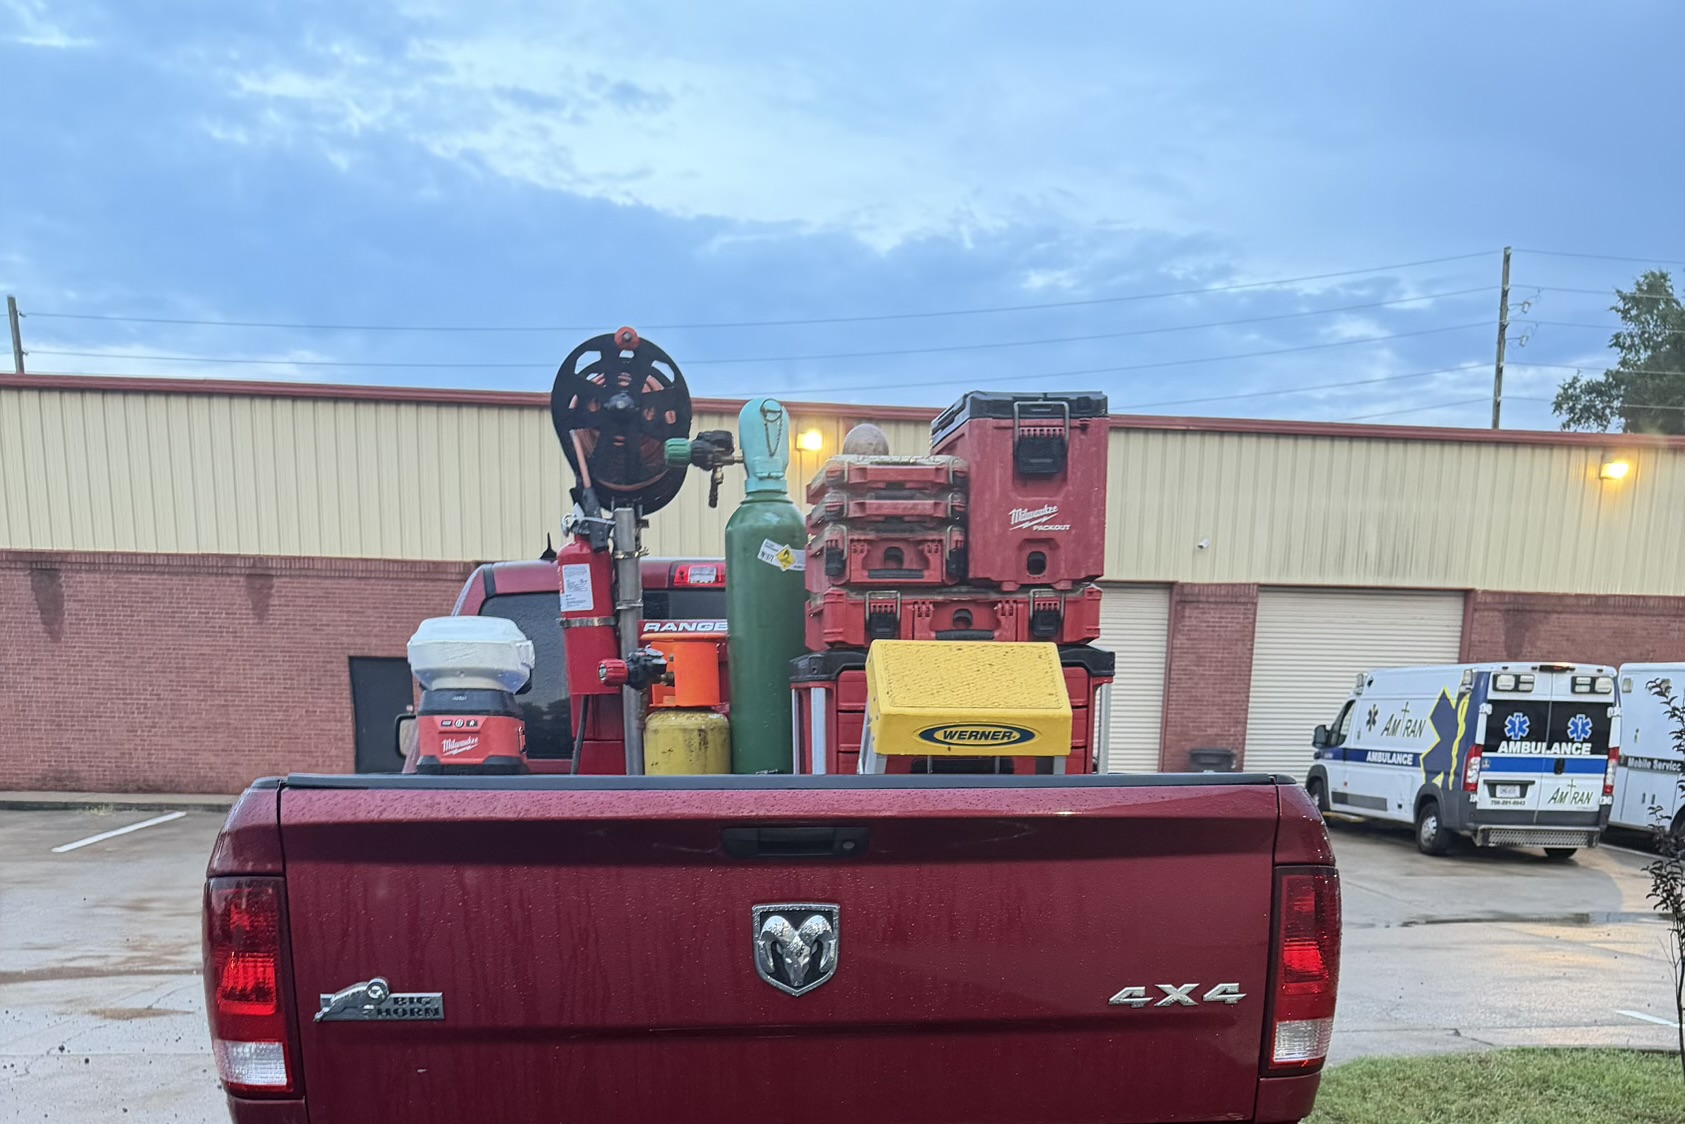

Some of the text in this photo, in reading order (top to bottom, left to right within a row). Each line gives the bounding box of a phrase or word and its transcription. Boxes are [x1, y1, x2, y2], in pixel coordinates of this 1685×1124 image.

[1033, 524, 1071, 532] PACKOUT
[643, 622, 729, 632] RANGE
[942, 730, 1014, 741] WERNER
[1497, 740, 1592, 756] AMBULANCE
[1365, 750, 1414, 766] AMBULANCE
[392, 996, 432, 1006] BIG
[375, 1006, 440, 1018] HORN
